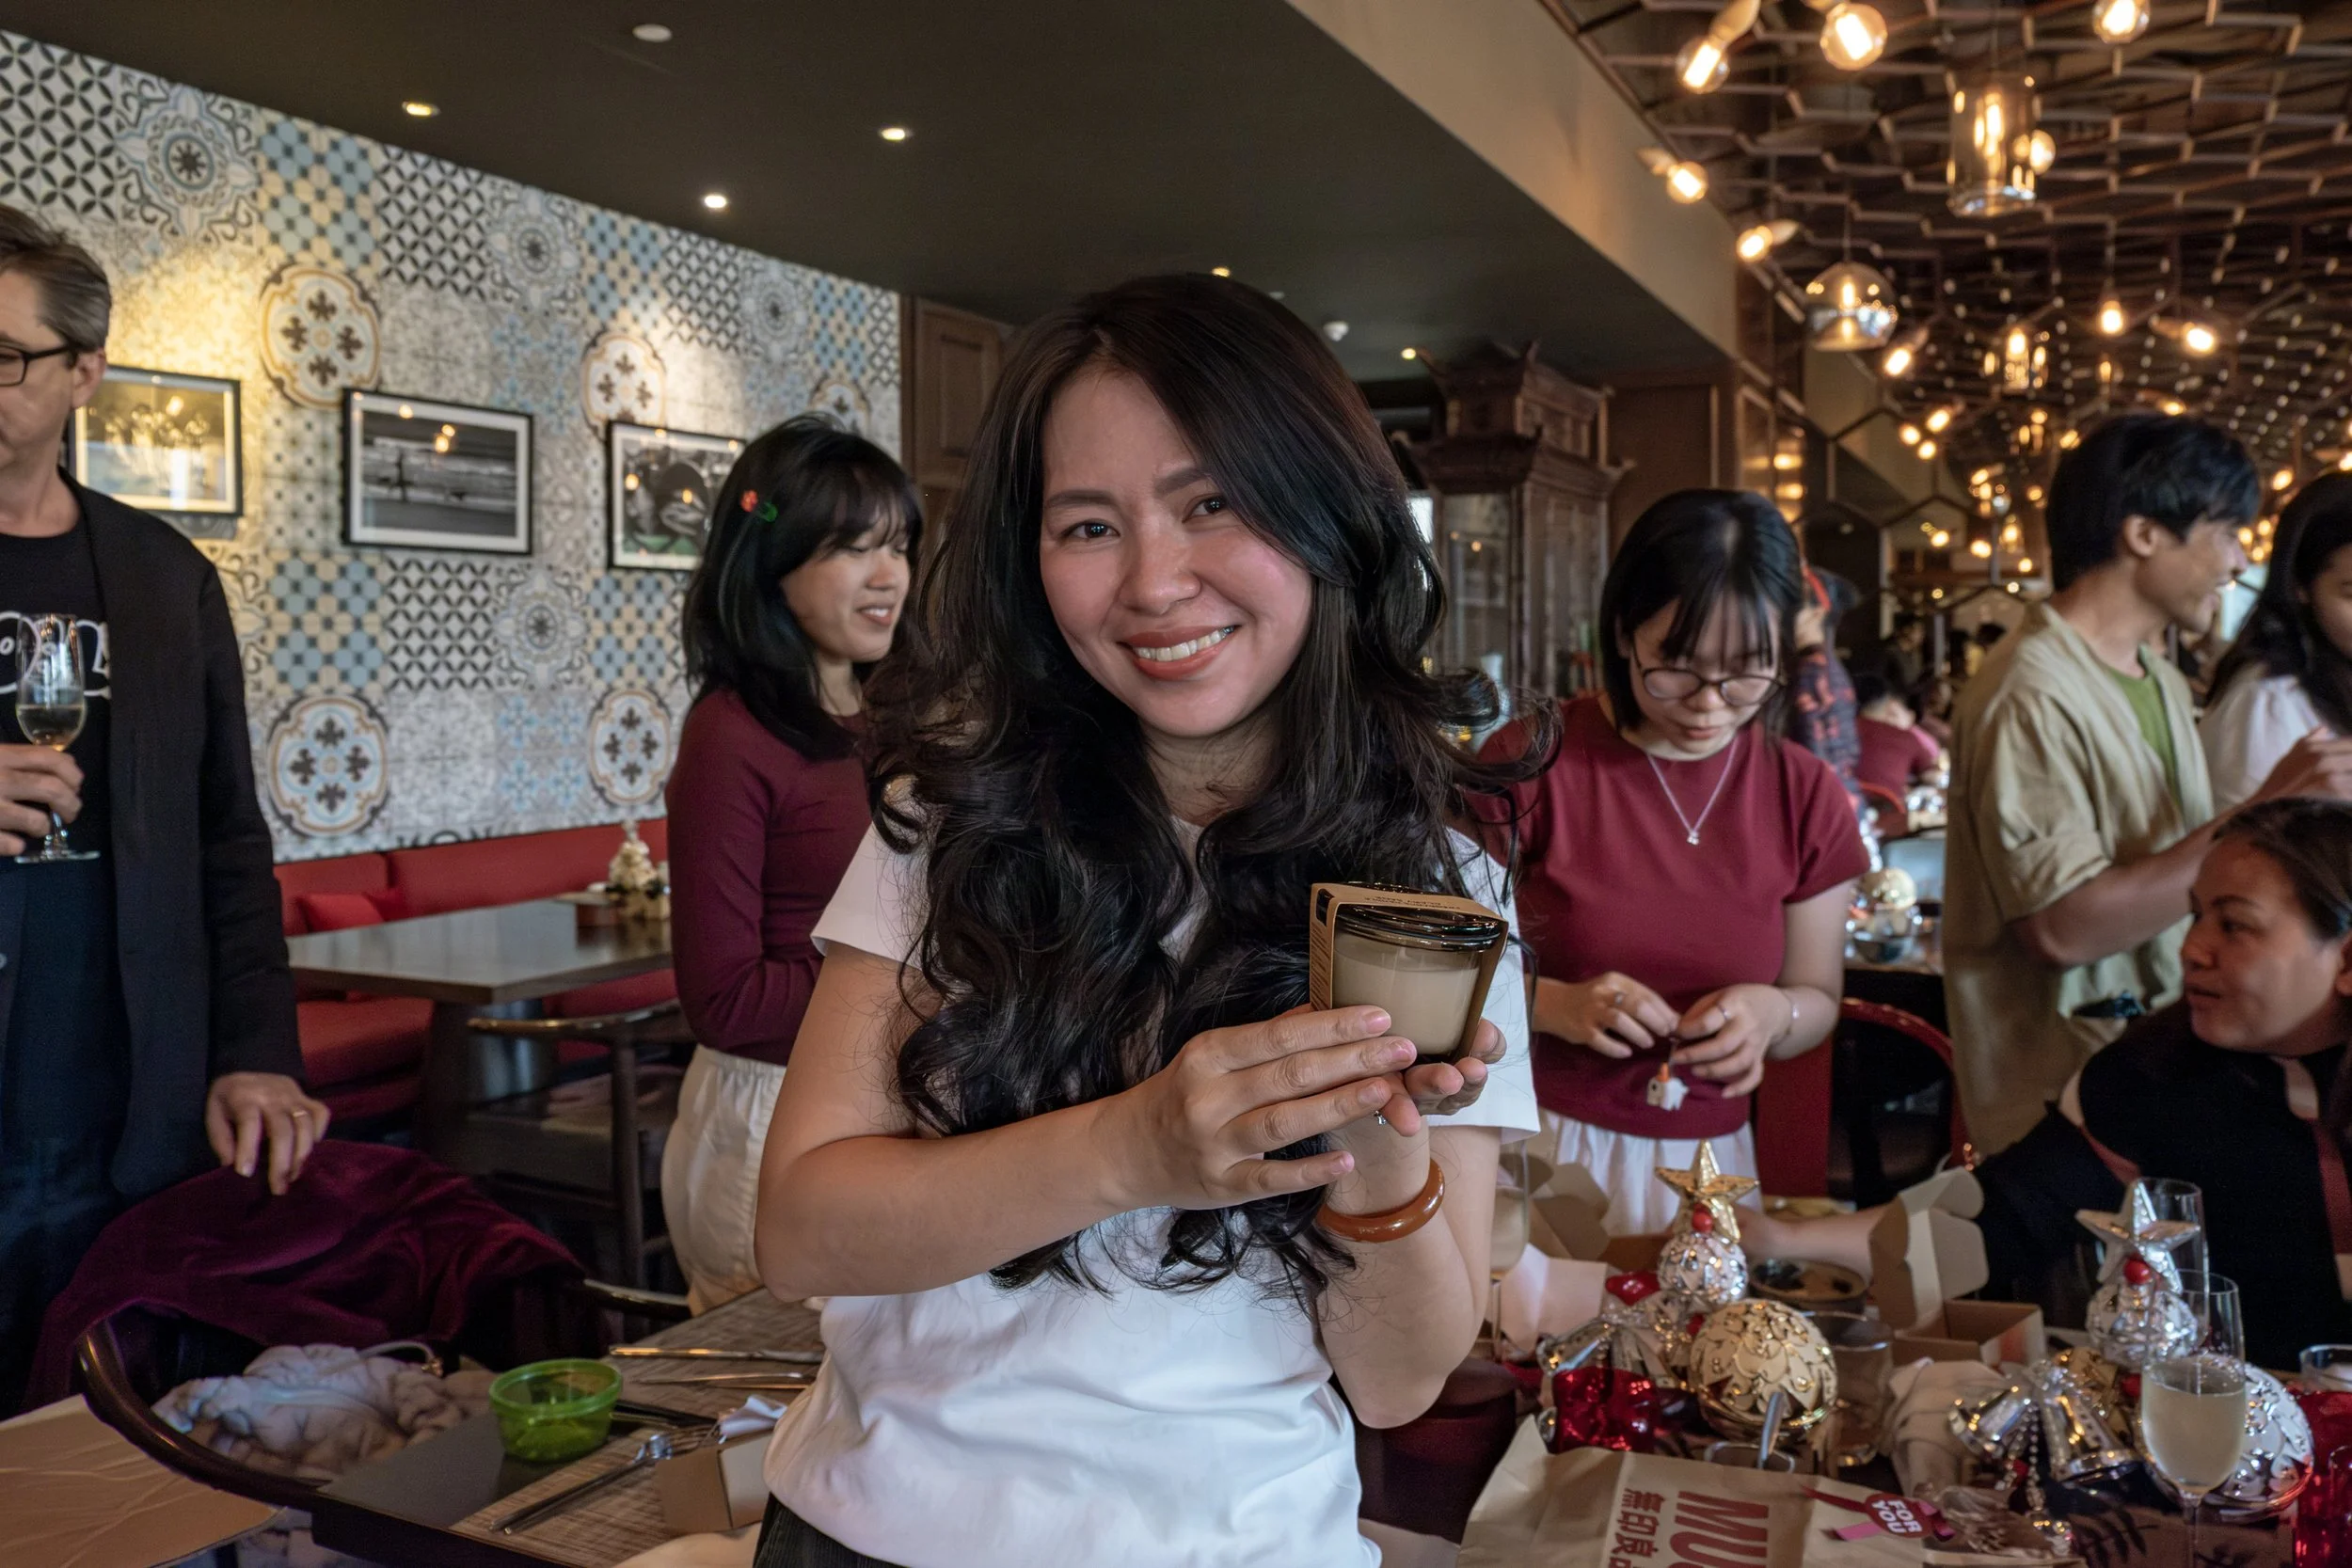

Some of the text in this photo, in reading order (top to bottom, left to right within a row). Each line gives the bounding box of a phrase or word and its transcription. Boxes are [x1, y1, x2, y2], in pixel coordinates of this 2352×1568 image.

[1670, 1491, 1769, 1568] MU
[1871, 1500, 1907, 1533] YOU
[1887, 1500, 1922, 1532] FOR
